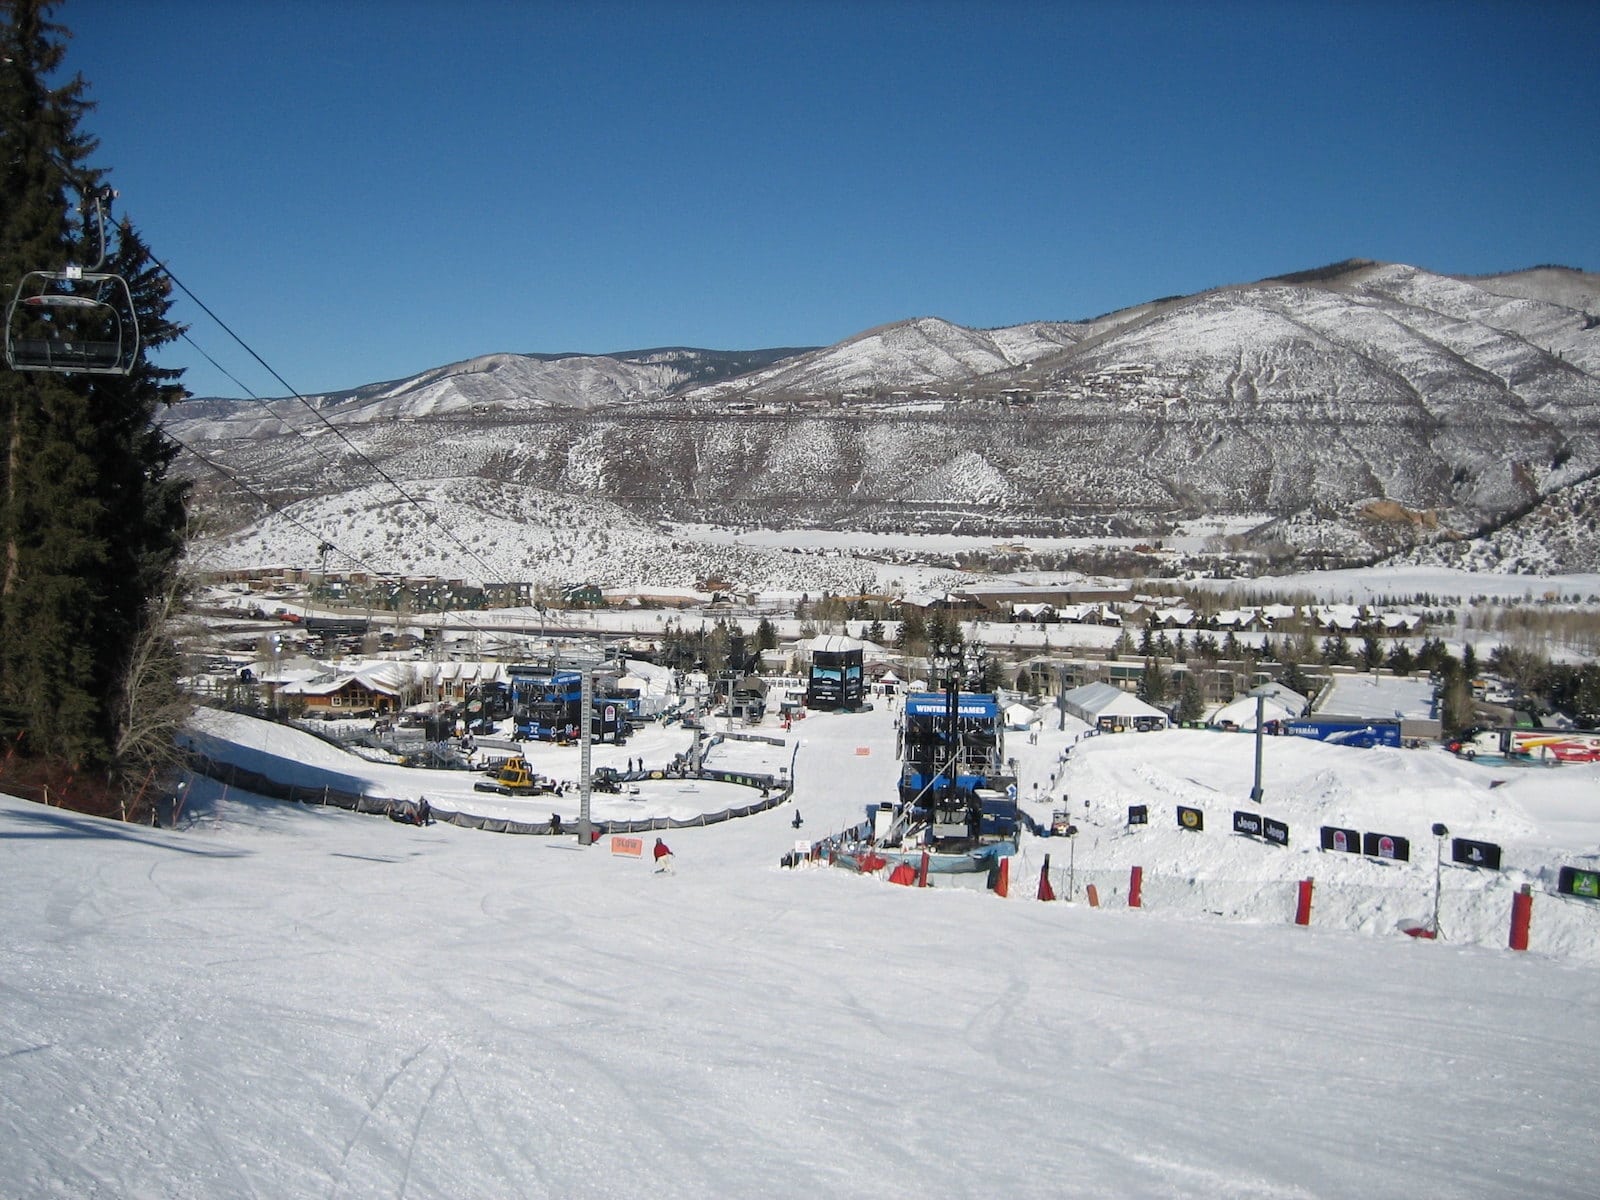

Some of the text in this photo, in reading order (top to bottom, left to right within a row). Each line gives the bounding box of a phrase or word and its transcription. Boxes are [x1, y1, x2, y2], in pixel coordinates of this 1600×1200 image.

[916, 704, 946, 713] WINTER
[957, 705, 986, 714] GAMES
[1295, 726, 1319, 735] YAMAHA
[1237, 815, 1258, 832] Jeep
[1266, 823, 1285, 841] Jeep
[615, 839, 638, 849] SLOW
